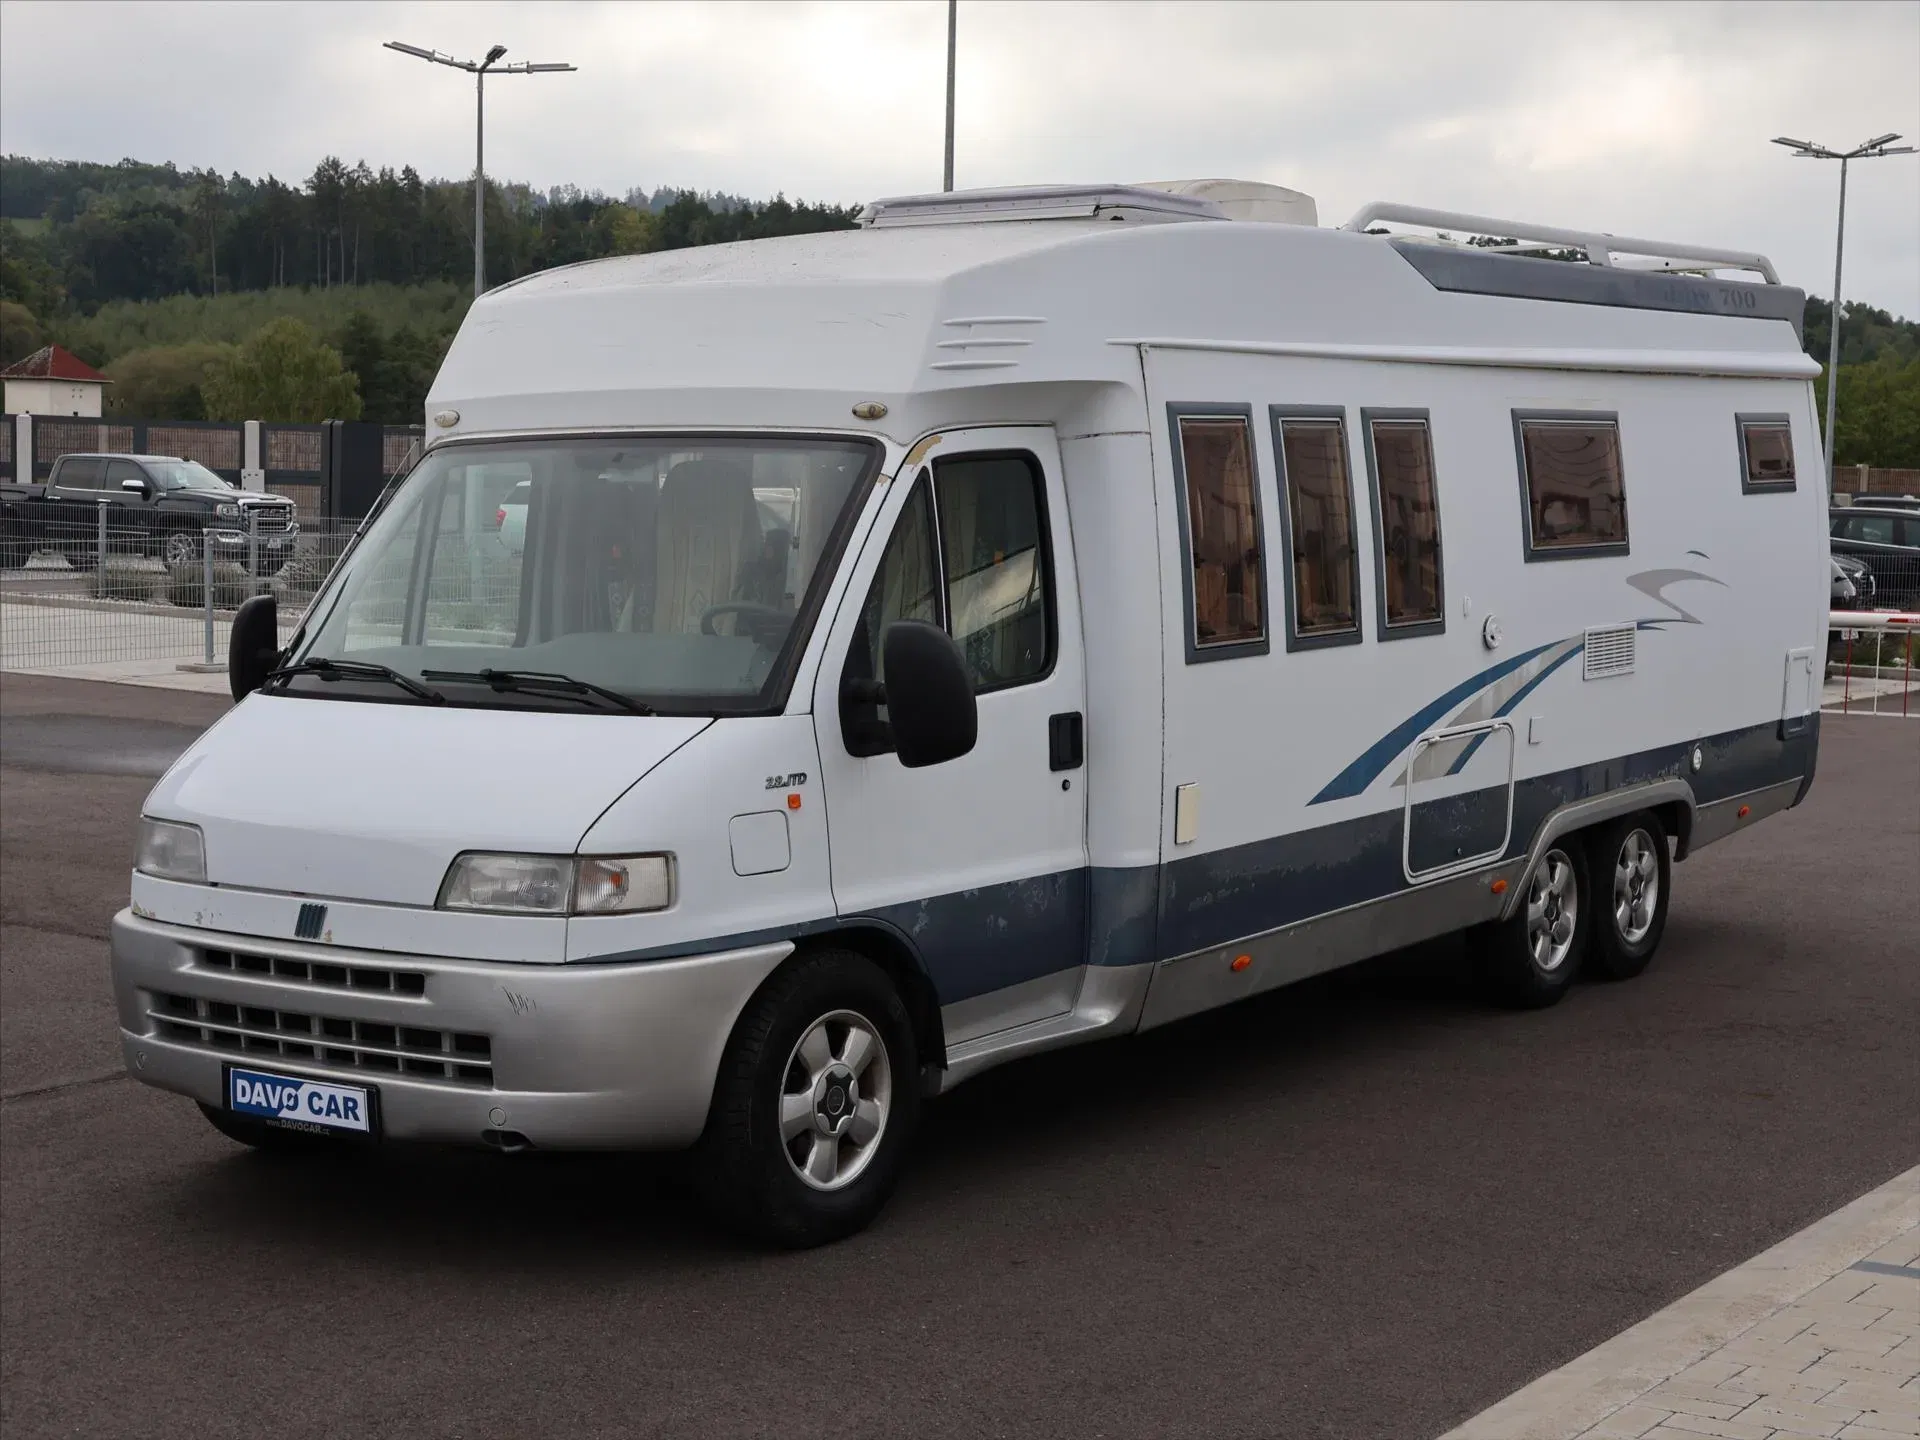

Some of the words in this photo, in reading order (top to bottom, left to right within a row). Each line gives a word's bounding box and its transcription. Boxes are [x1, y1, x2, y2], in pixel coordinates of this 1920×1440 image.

[1719, 288, 1756, 308] 700
[236, 1078, 299, 1112] DAVO
[306, 1090, 361, 1122] CAR
